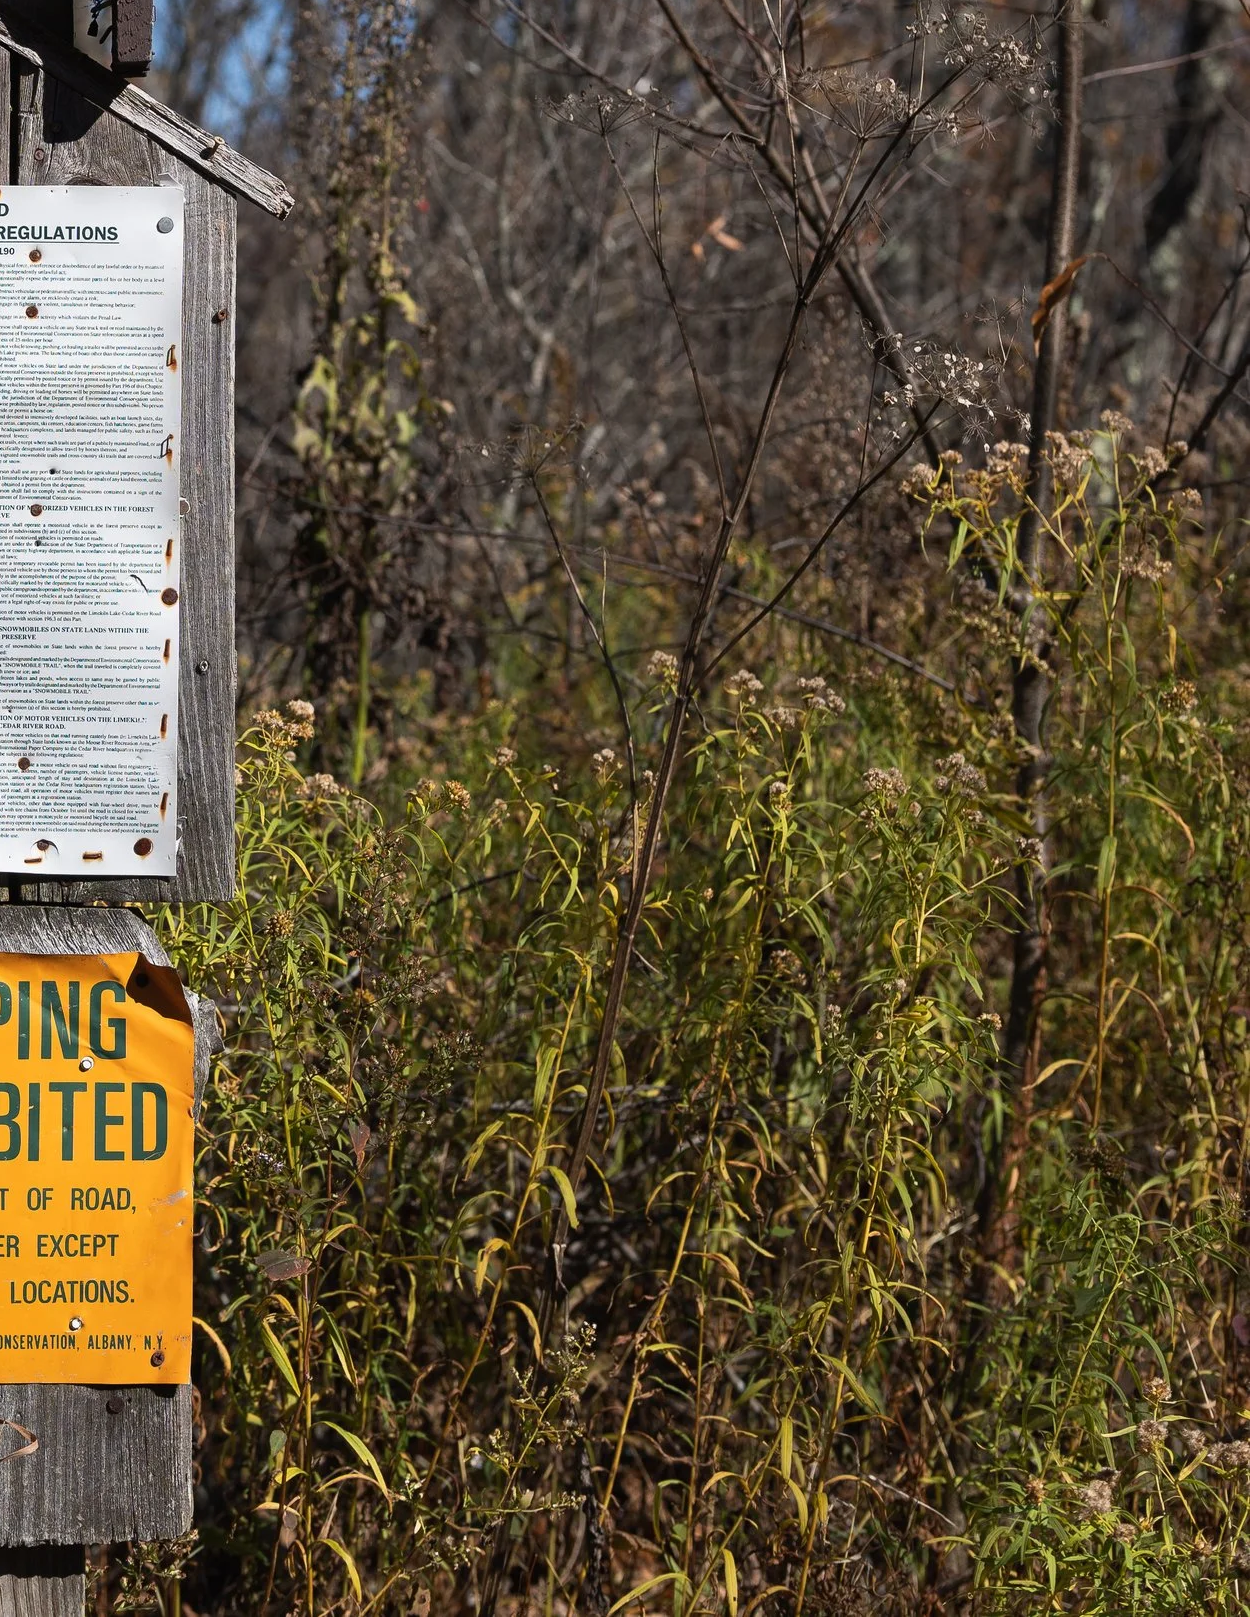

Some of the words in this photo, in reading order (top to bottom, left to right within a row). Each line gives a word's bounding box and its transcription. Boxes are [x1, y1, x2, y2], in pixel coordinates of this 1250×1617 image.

[15, 503, 25, 511] OF
[27, 503, 68, 512] MORIZED
[69, 504, 103, 512] VEHICLES
[128, 505, 154, 513] FOREST
[50, 625, 60, 633] ON
[61, 625, 83, 633] STATE
[84, 626, 106, 634] LANDS
[107, 626, 133, 634] WITHIN
[135, 626, 148, 634] THE
[1, 632, 36, 641] PRESERVE
[13, 714, 23, 722] OF
[24, 714, 49, 722] MOTOR
[51, 714, 85, 723] VEHICLES
[86, 715, 96, 723] ON
[97, 715, 111, 723] THE
[22, 722, 43, 730] RIVER
[45, 722, 66, 730] ROAD.
[26, 1187, 54, 1211] OF
[70, 1187, 137, 1215] ROAD,
[37, 1233, 120, 1257] EXCEPT
[10, 1280, 135, 1304] LOCATIONS.
[87, 1335, 136, 1352] ALBANY,
[144, 1335, 167, 1350] N.Y.
